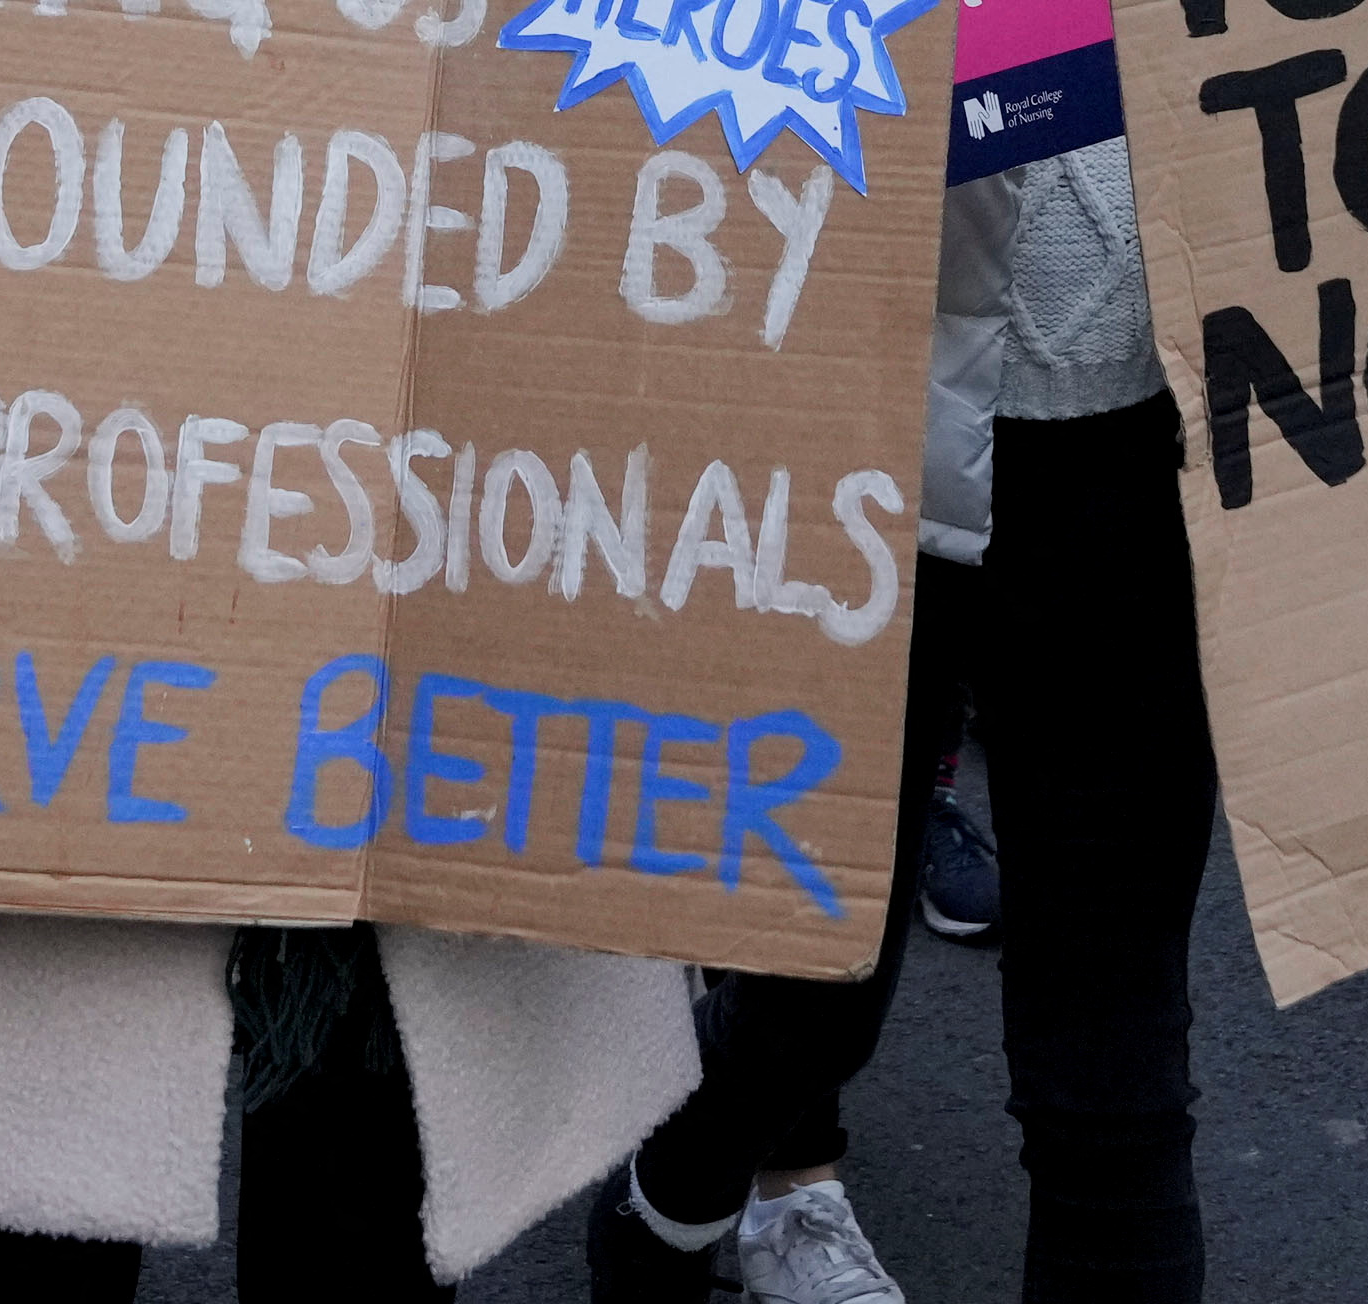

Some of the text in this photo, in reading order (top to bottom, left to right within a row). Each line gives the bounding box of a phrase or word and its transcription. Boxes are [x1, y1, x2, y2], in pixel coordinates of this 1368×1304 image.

[1004, 89, 1063, 114] Royal College
[1007, 107, 1054, 128] of Nursing
[620, 149, 834, 352] BY
[284, 653, 848, 922] BETTER
